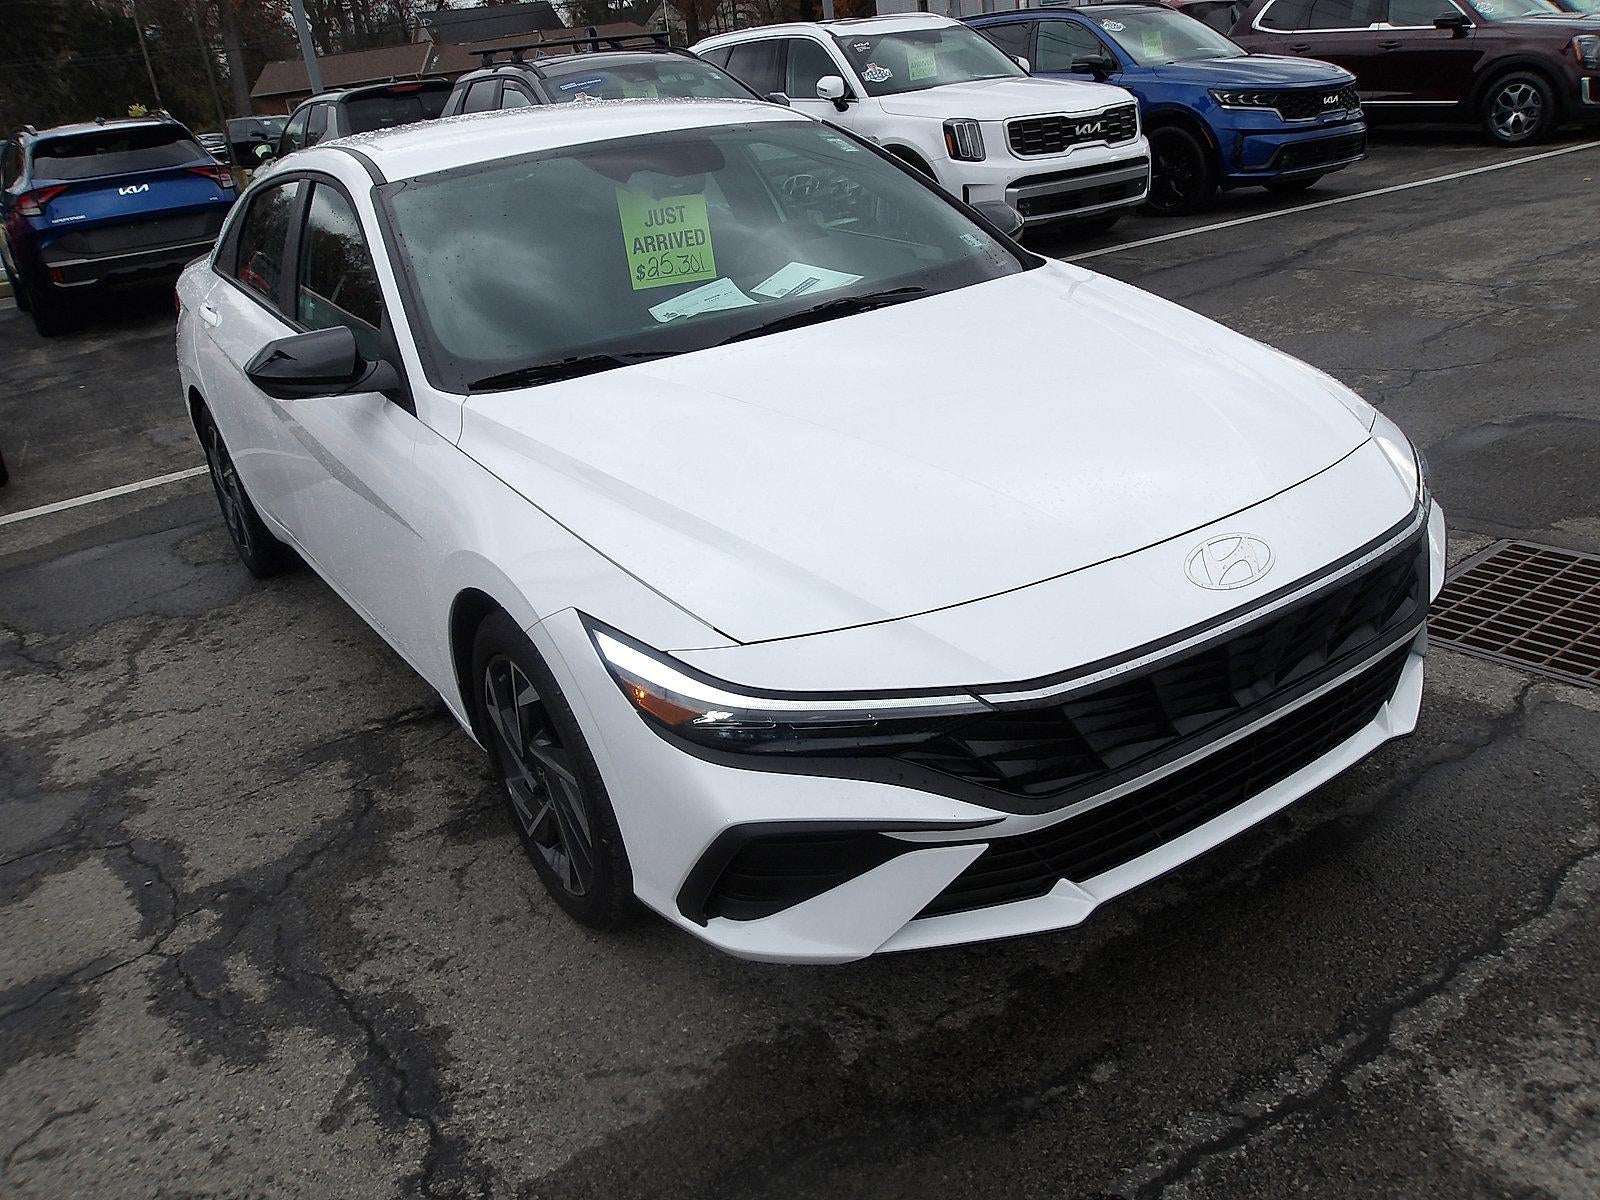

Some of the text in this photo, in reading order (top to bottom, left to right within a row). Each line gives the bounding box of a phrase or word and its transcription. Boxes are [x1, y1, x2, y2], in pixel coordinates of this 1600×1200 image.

[1075, 122, 1103, 136] KIA
[118, 183, 149, 196] KIA
[644, 205, 685, 228] JUST
[633, 229, 705, 254] ARRIVED
